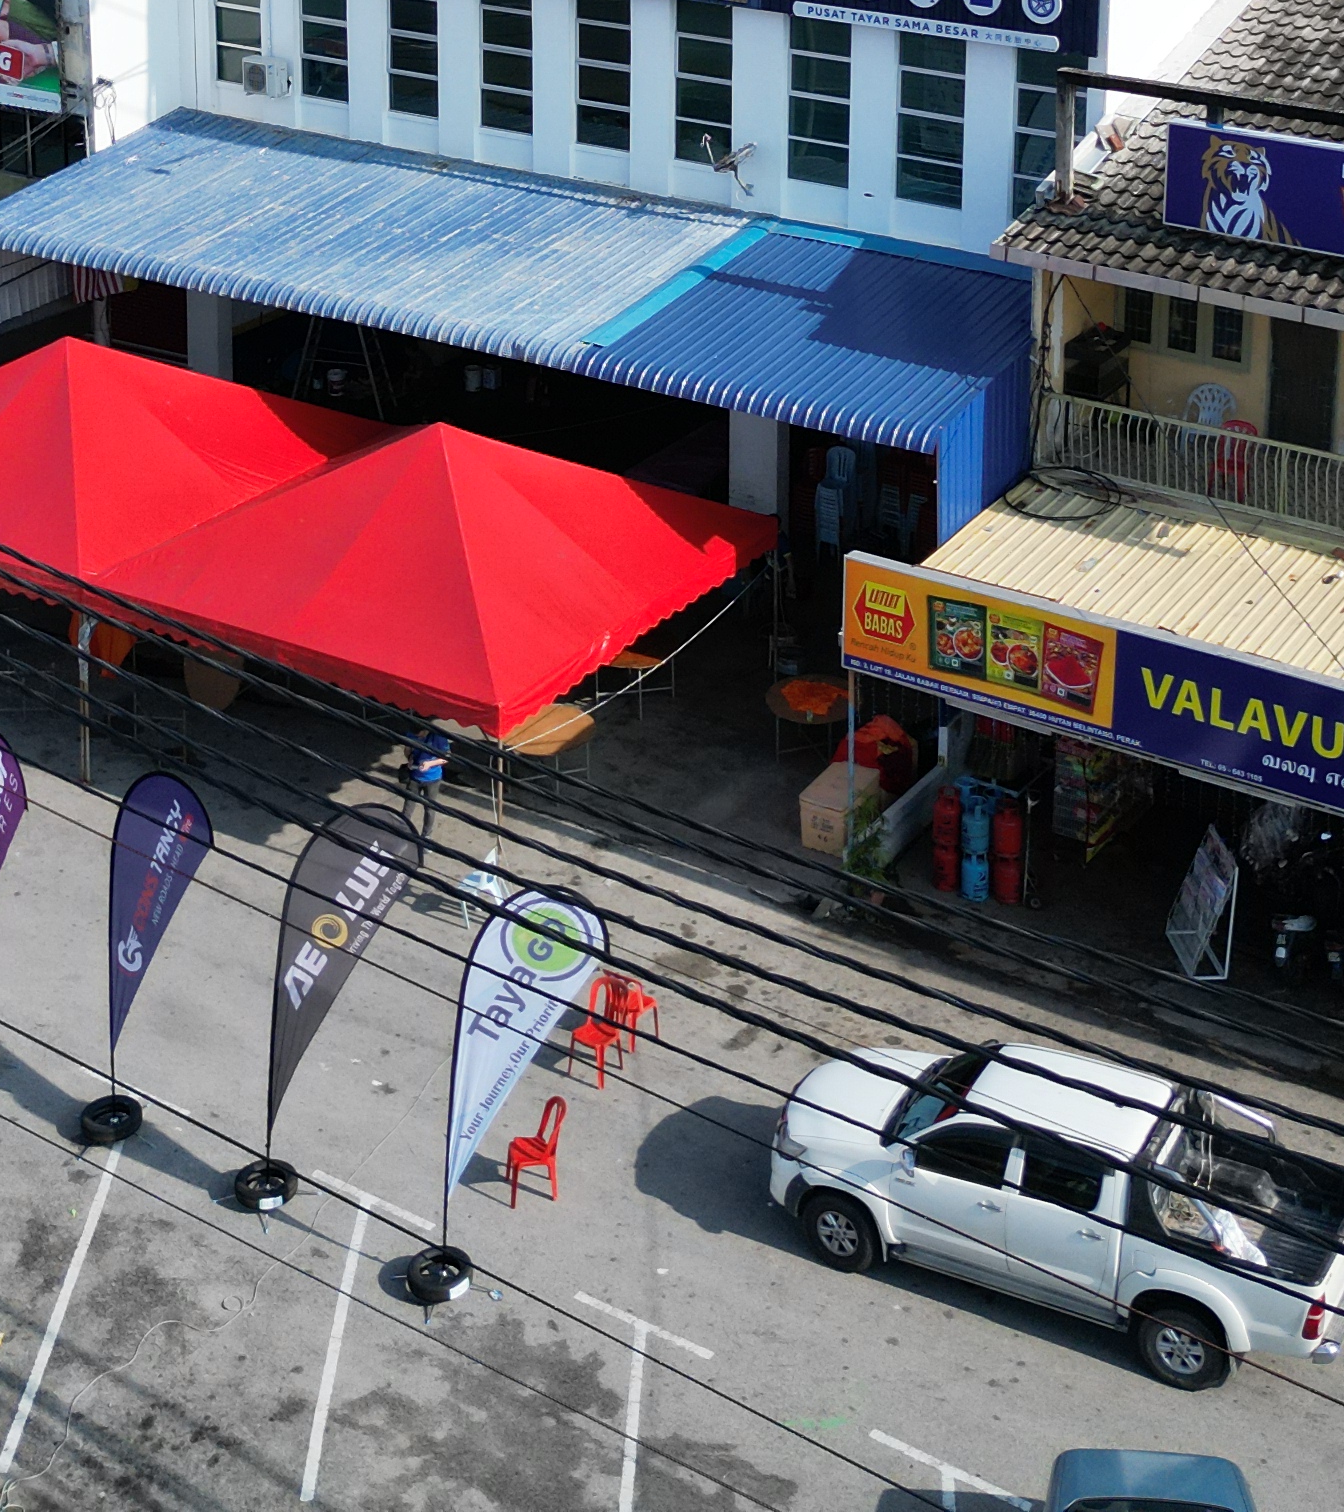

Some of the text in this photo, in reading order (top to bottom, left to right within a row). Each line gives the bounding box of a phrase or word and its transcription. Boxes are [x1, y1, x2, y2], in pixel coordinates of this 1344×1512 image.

[807, 6, 979, 38] PUSAT TAYAR SAMA BESAR
[894, 671, 915, 683] JALAN
[1262, 754, 1316, 783] வலவு
[152, 843, 185, 927] NEW ROADS HEAD
[369, 893, 391, 917] World
[459, 1111, 484, 1142] Your
[525, 996, 559, 1040] Priorit
